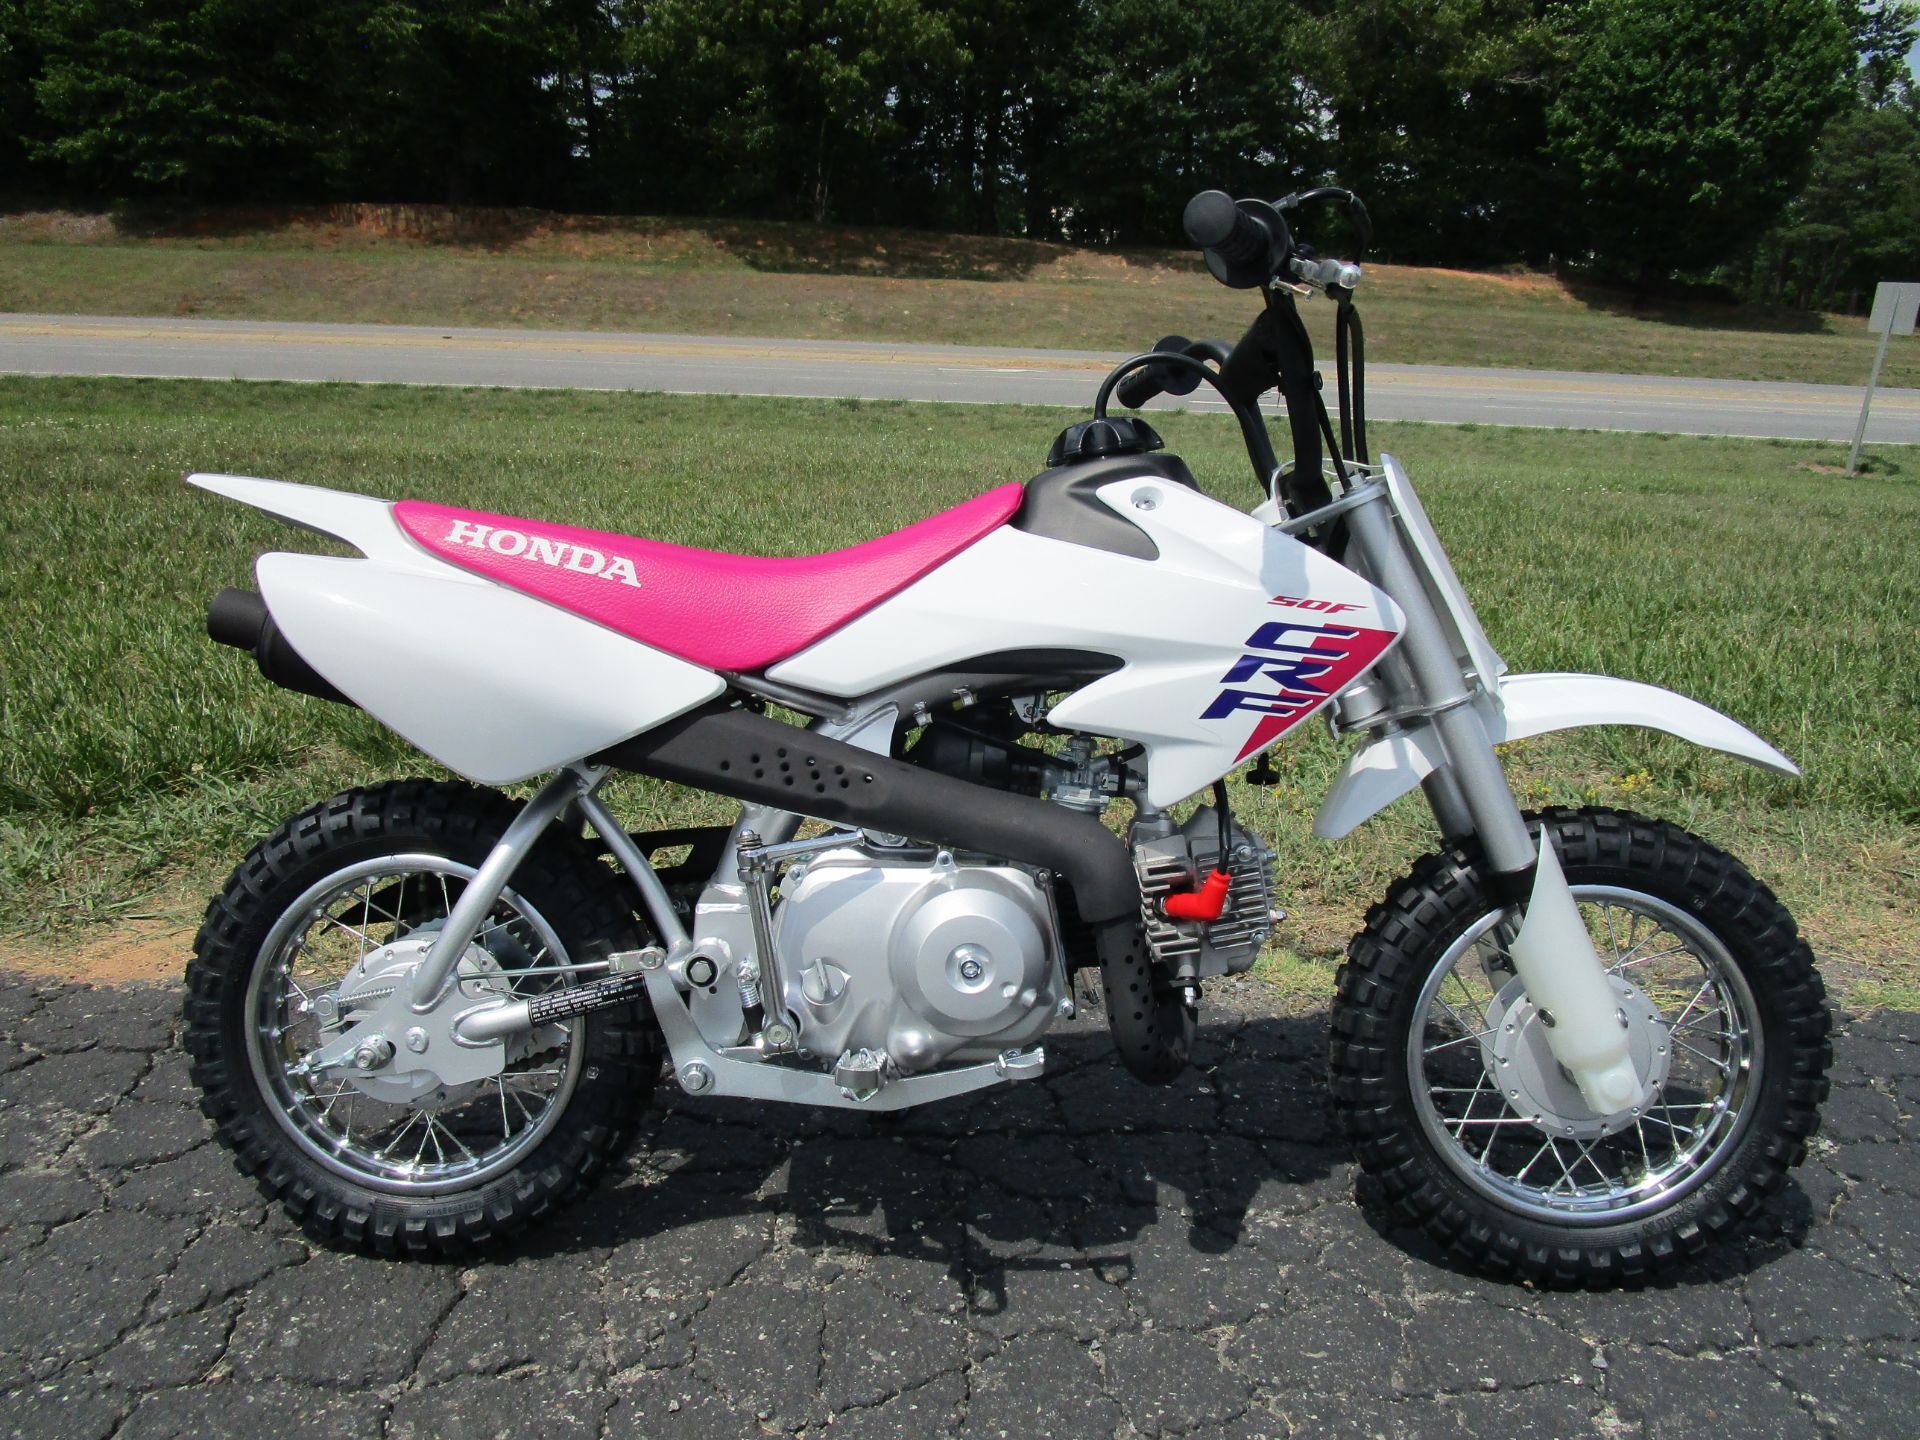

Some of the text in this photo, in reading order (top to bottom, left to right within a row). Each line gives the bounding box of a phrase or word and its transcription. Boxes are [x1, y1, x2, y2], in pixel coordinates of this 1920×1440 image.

[444, 519, 642, 588] HONDA
[1267, 595, 1369, 614] 50F
[1198, 621, 1360, 720] CRF
